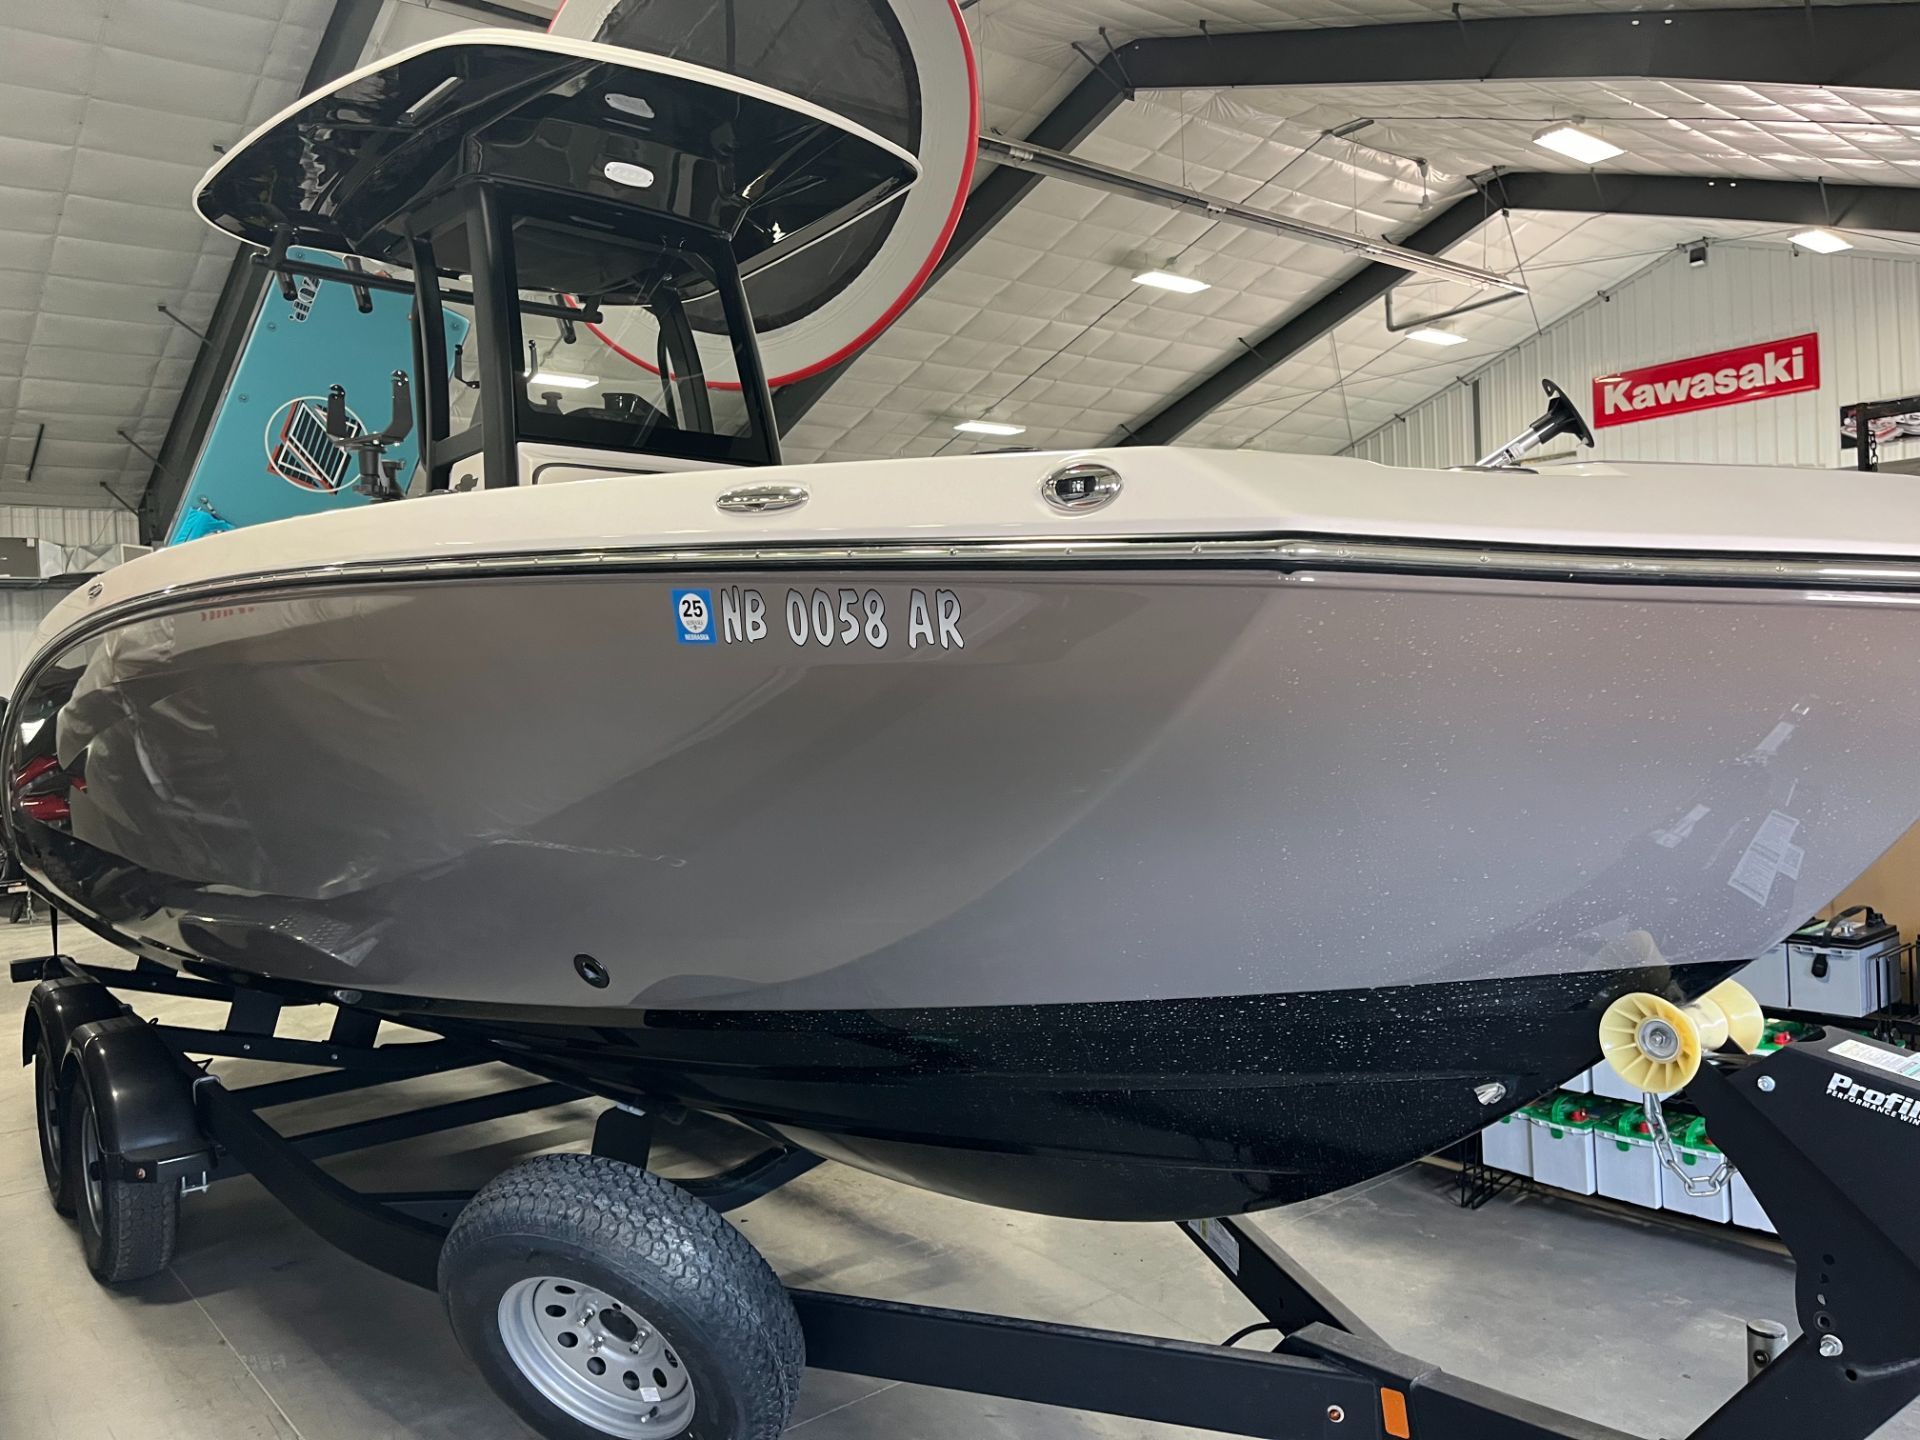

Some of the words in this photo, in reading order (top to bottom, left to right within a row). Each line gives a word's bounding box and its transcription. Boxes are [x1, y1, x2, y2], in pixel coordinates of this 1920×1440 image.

[1604, 347, 1803, 415] Kawasaki
[682, 599, 703, 617] 25
[721, 585, 768, 644] NB
[786, 588, 889, 648] 0058
[908, 588, 965, 650] AR
[1825, 1089, 1898, 1118] PERFORMANCE
[1827, 1072, 1920, 1119] Profil
